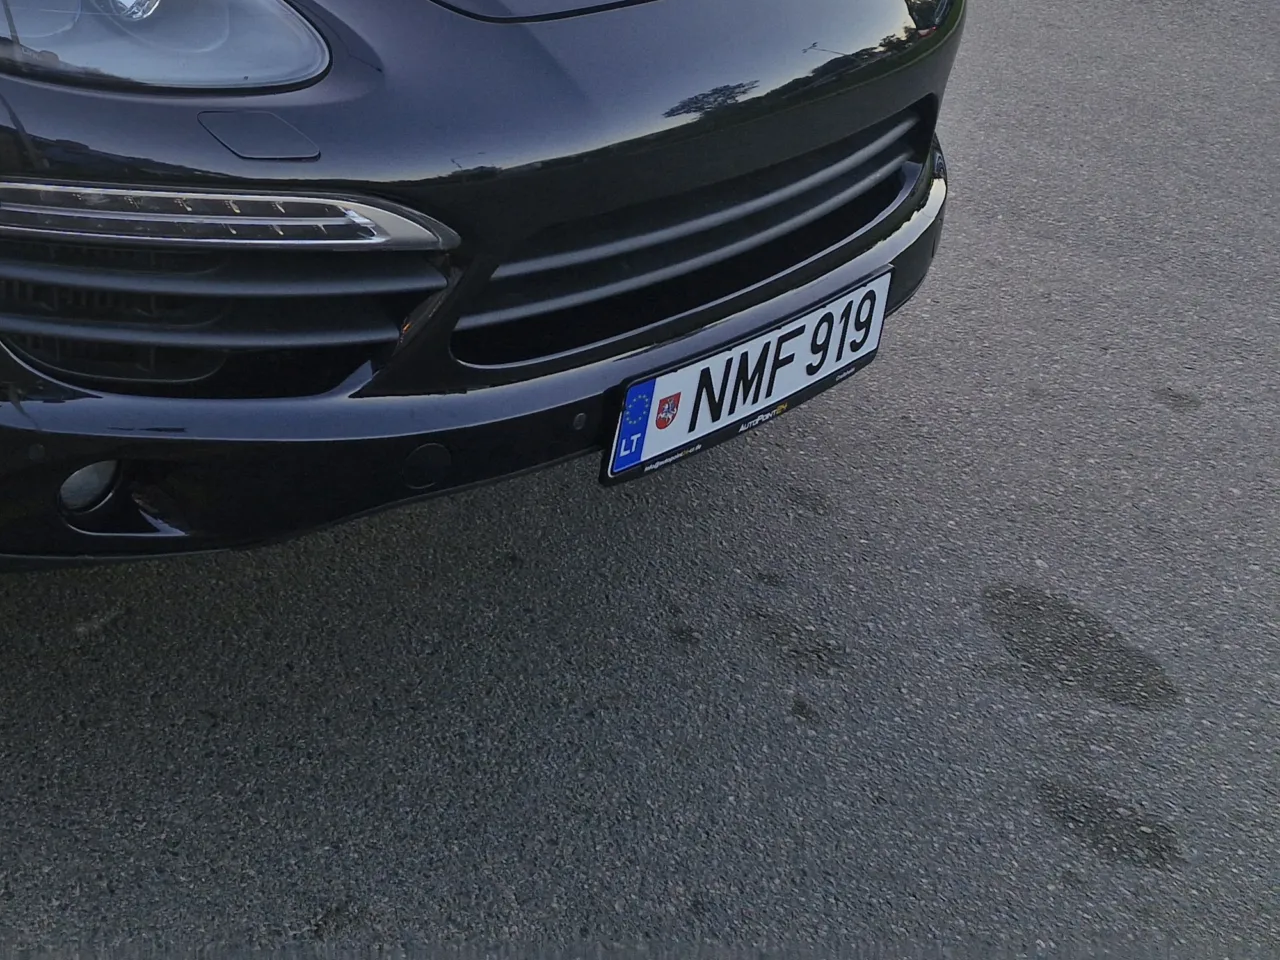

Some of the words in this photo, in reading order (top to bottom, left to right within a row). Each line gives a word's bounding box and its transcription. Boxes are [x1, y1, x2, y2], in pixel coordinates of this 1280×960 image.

[688, 324, 806, 434] NMF
[805, 289, 877, 376] 919
[619, 433, 642, 458] LT
